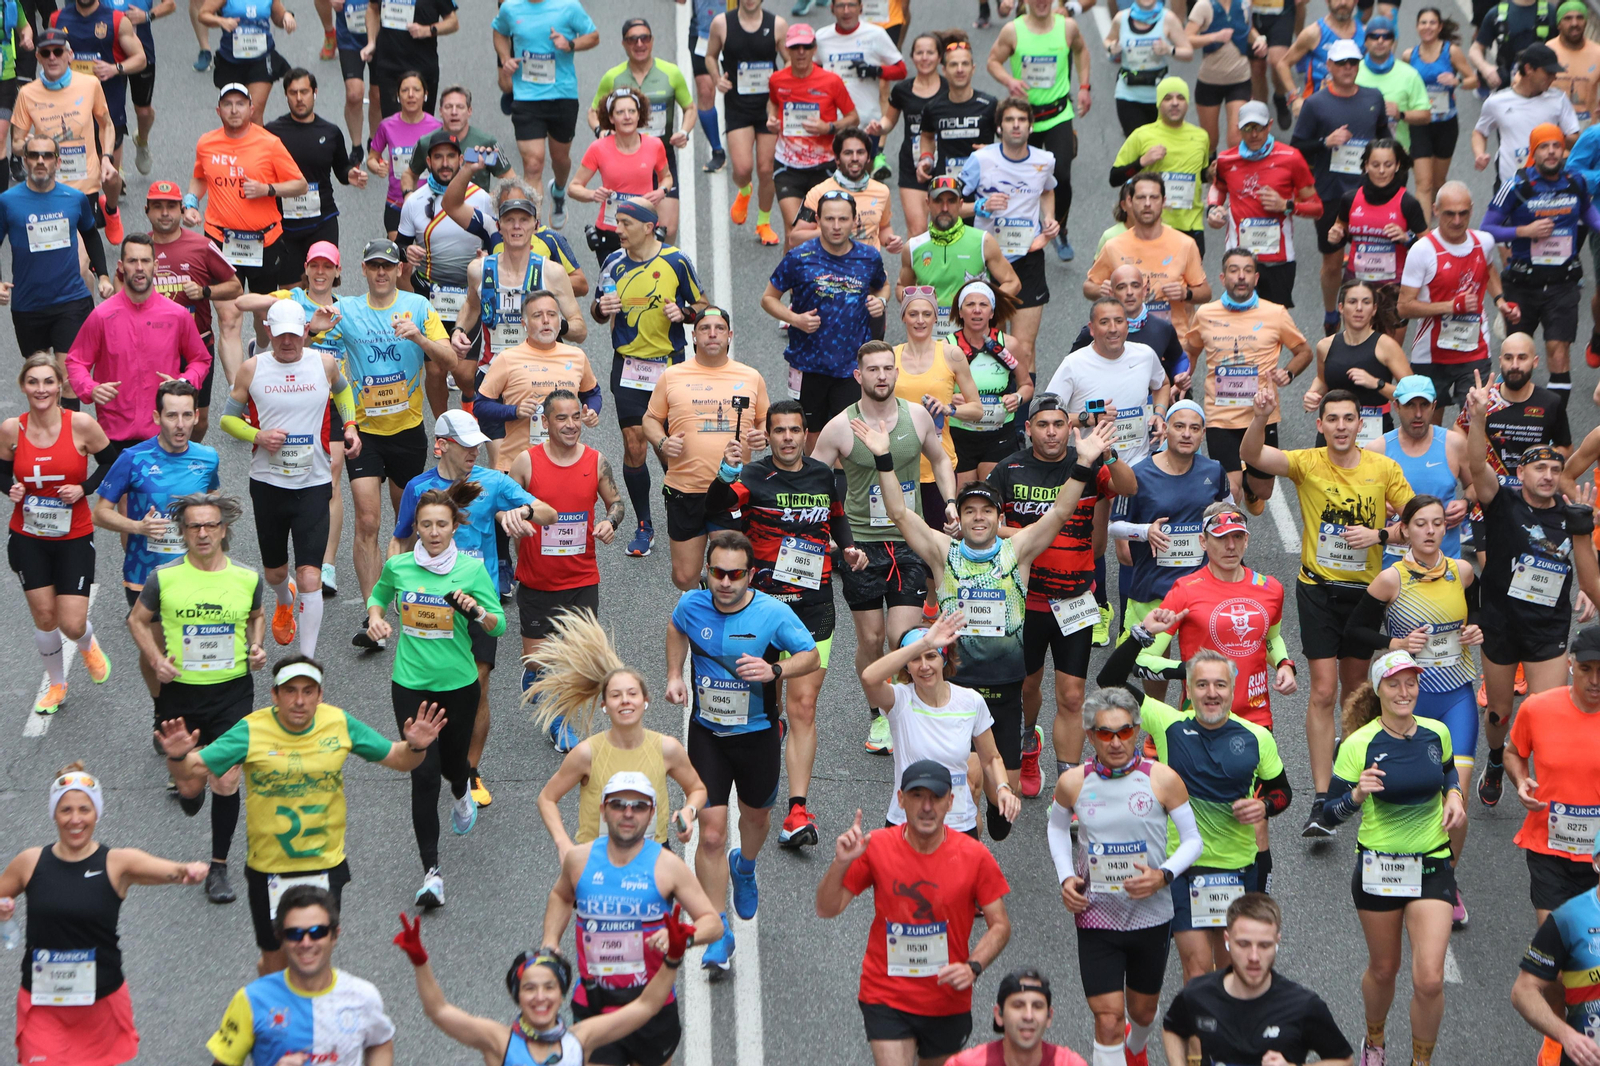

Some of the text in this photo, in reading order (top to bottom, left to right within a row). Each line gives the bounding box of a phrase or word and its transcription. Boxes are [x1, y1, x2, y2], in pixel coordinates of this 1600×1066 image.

[211, 154, 238, 165] NEV
[230, 167, 244, 177] ER
[214, 177, 244, 188] GIVE
[40, 212, 64, 221] ZURICH
[39, 225, 59, 233] 10474
[237, 233, 260, 241] ZURICH
[1368, 245, 1391, 253] ZURICH
[442, 284, 465, 293] ZURICH
[1146, 303, 1166, 311] URICH
[502, 328, 519, 336] 8949
[1228, 367, 1253, 376] ZURICH
[375, 374, 402, 384] ZURICH
[264, 383, 317, 395] DANMARK
[531, 380, 555, 389] Maratón
[377, 389, 394, 398] 4870
[691, 398, 718, 406] Maratón
[1116, 408, 1141, 418] ZURICH
[1116, 424, 1133, 432] 9748
[284, 436, 309, 444] ZURICH
[281, 450, 299, 458] 8935
[283, 460, 299, 469] Benny
[1014, 484, 1029, 500] EL
[40, 498, 67, 508] ZURICH
[777, 494, 790, 507] JJ
[36, 511, 58, 520] 10318
[558, 514, 584, 522] ZURICH
[780, 507, 796, 523] &
[557, 528, 574, 536] 7541
[1174, 524, 1200, 532] ZURICH
[798, 542, 822, 553] ZURICH
[1173, 539, 1190, 547] 9391
[794, 555, 811, 565] 8615
[1535, 559, 1563, 572] ZURICH
[792, 567, 815, 578] RUNNING
[1530, 573, 1549, 584] 8815
[972, 589, 1001, 599] ZURICH
[418, 594, 448, 605] ZURICH
[1068, 598, 1086, 611] 8758
[969, 606, 992, 615] 10063
[417, 611, 436, 620] 5958
[1062, 613, 1081, 625] GORDO
[200, 625, 230, 635] ZURICH
[1435, 623, 1460, 633] ZURICH
[1249, 670, 1266, 687] RUN
[713, 681, 744, 689] ZURICH
[1248, 685, 1267, 699] NING
[712, 695, 731, 704] 8945
[1569, 808, 1600, 817] ZURICH
[1566, 822, 1588, 832] 8275
[1555, 833, 1576, 843] Duarte
[1107, 844, 1140, 853] ZURICH
[1107, 862, 1129, 871] 9430
[1380, 863, 1405, 872] 10199
[1105, 873, 1134, 882] VELASCO
[1208, 876, 1239, 885] ZURICH
[1381, 877, 1403, 885] ROCKY
[1208, 891, 1230, 902] 9076
[600, 921, 635, 932] ZURICH
[906, 924, 940, 935] ZURICH
[601, 940, 622, 950] 7580
[52, 951, 89, 963] ZURICH
[599, 954, 625, 963] MIGUEL
